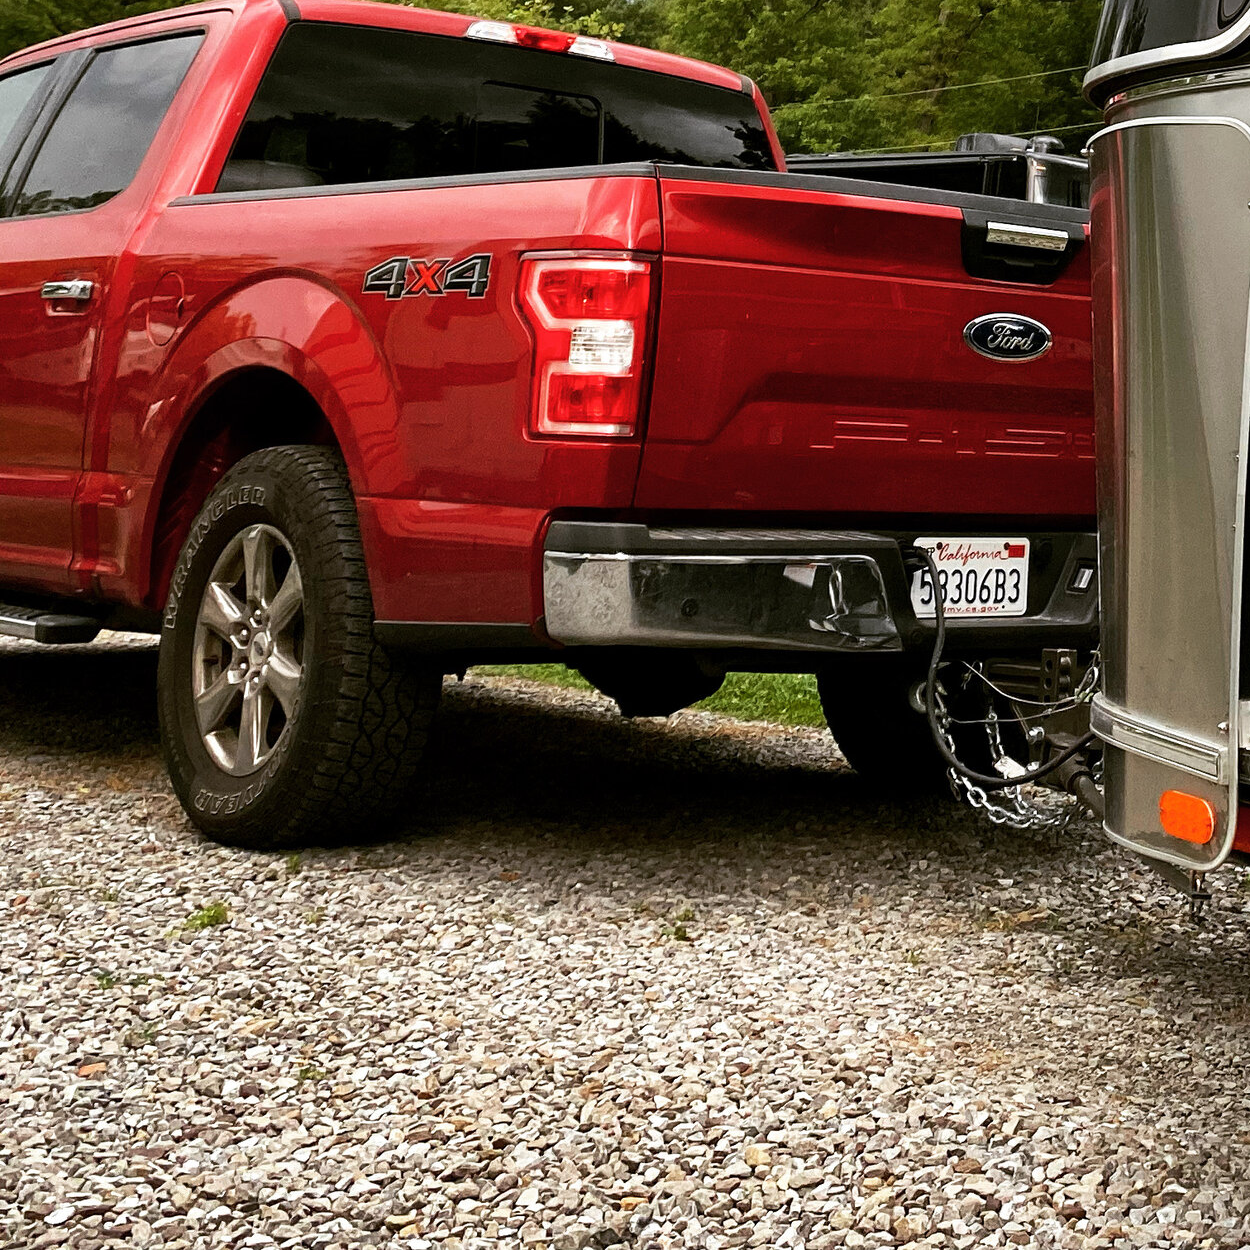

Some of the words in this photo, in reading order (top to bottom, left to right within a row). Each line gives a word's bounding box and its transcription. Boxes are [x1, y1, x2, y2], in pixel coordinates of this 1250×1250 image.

[987, 322, 1034, 350] Ford
[810, 414, 1094, 459] F-15
[938, 543, 1008, 566] California
